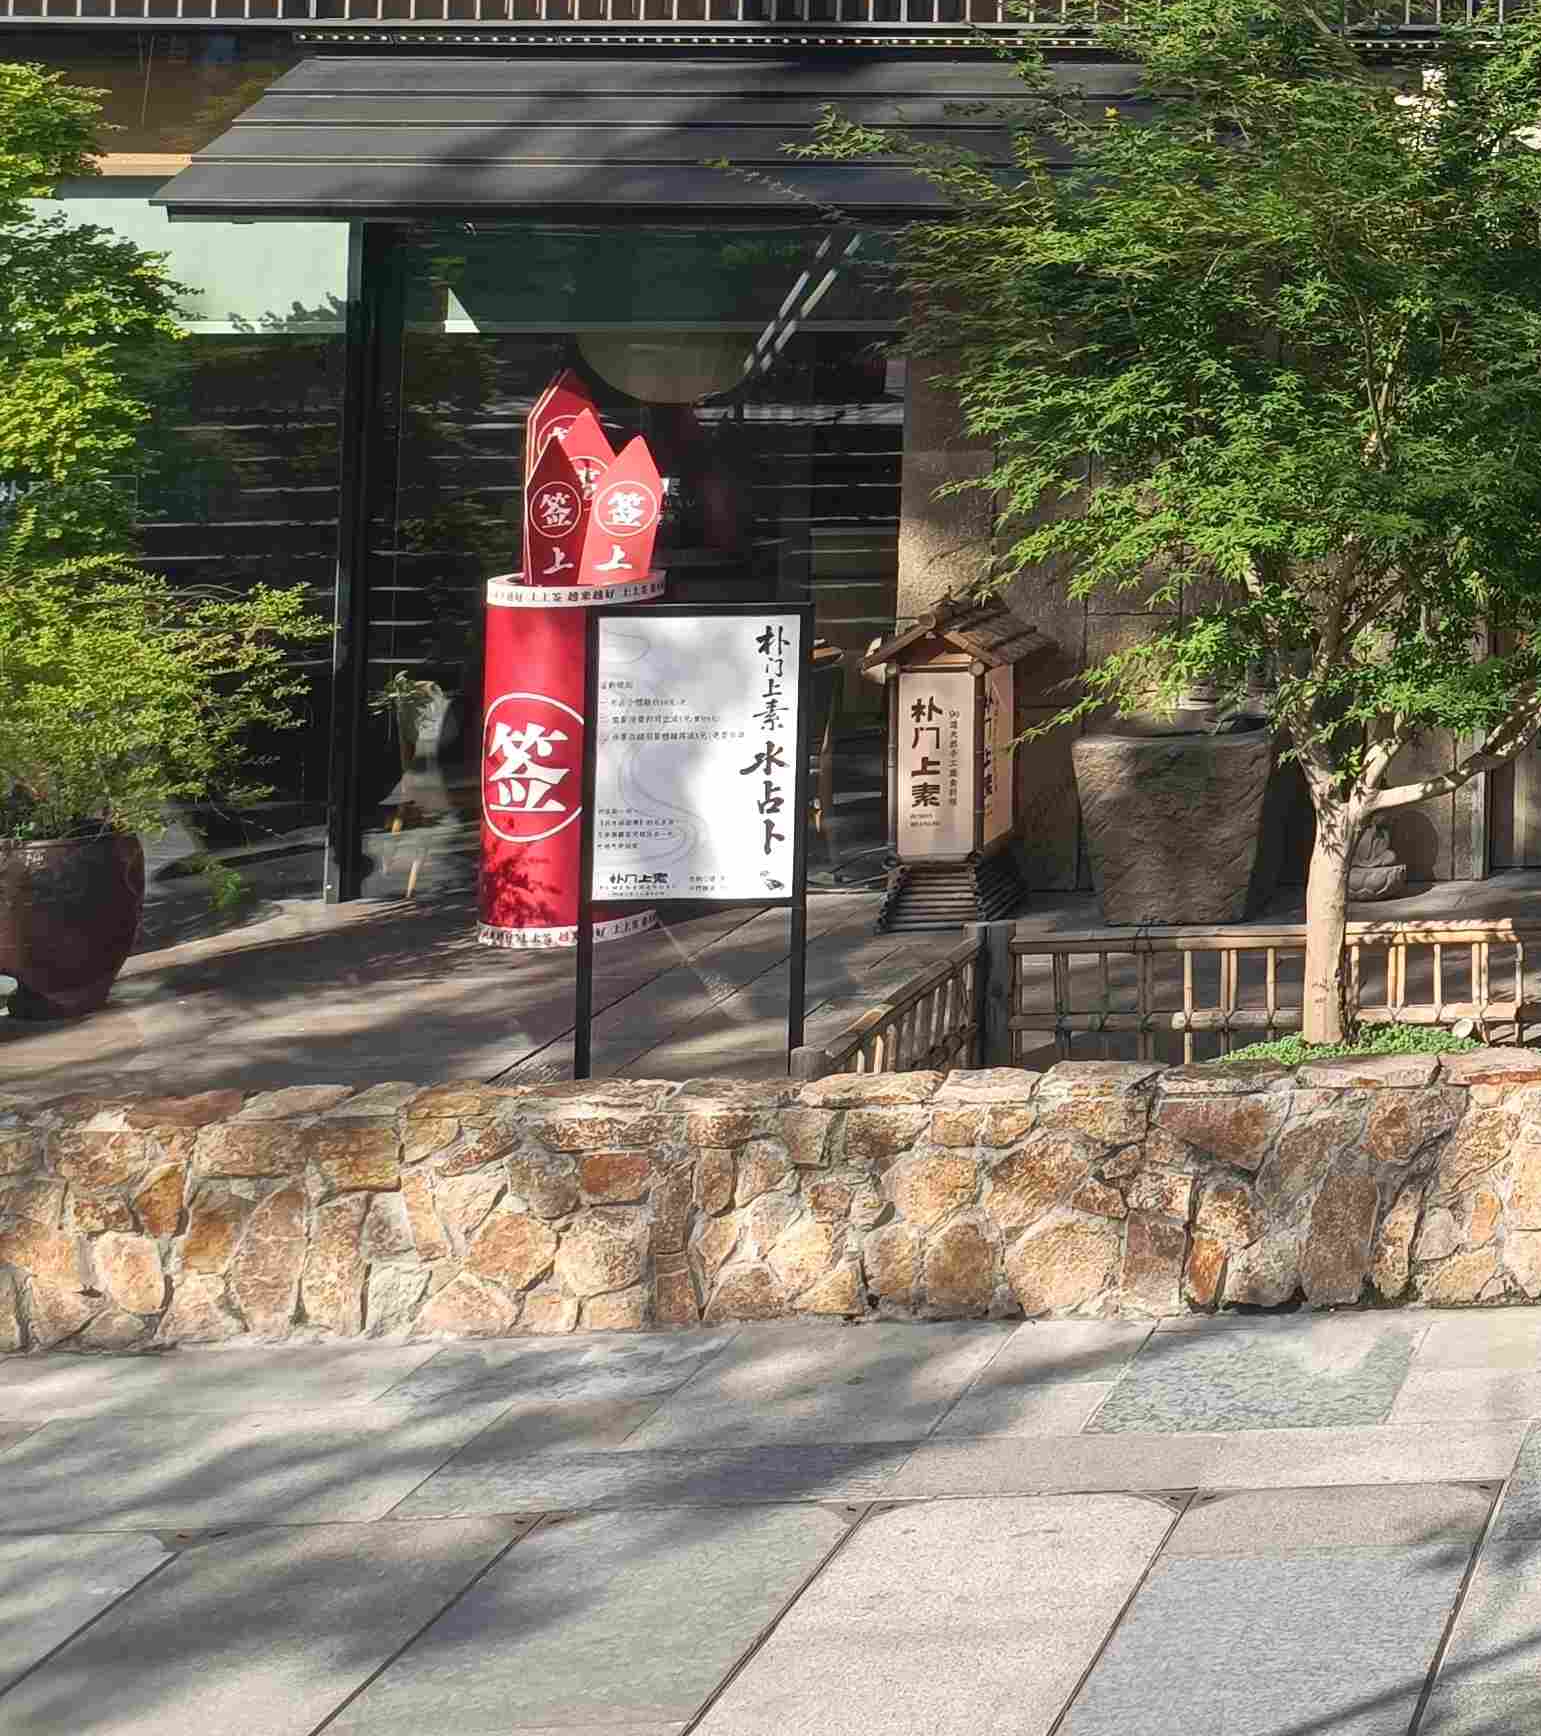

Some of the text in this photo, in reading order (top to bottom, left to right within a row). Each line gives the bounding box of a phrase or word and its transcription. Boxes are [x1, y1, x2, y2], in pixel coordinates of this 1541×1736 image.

[540, 492, 574, 575] 签 上
[593, 492, 646, 571] 签 上
[488, 722, 571, 813] 签
[910, 695, 944, 808] 朴门上素
